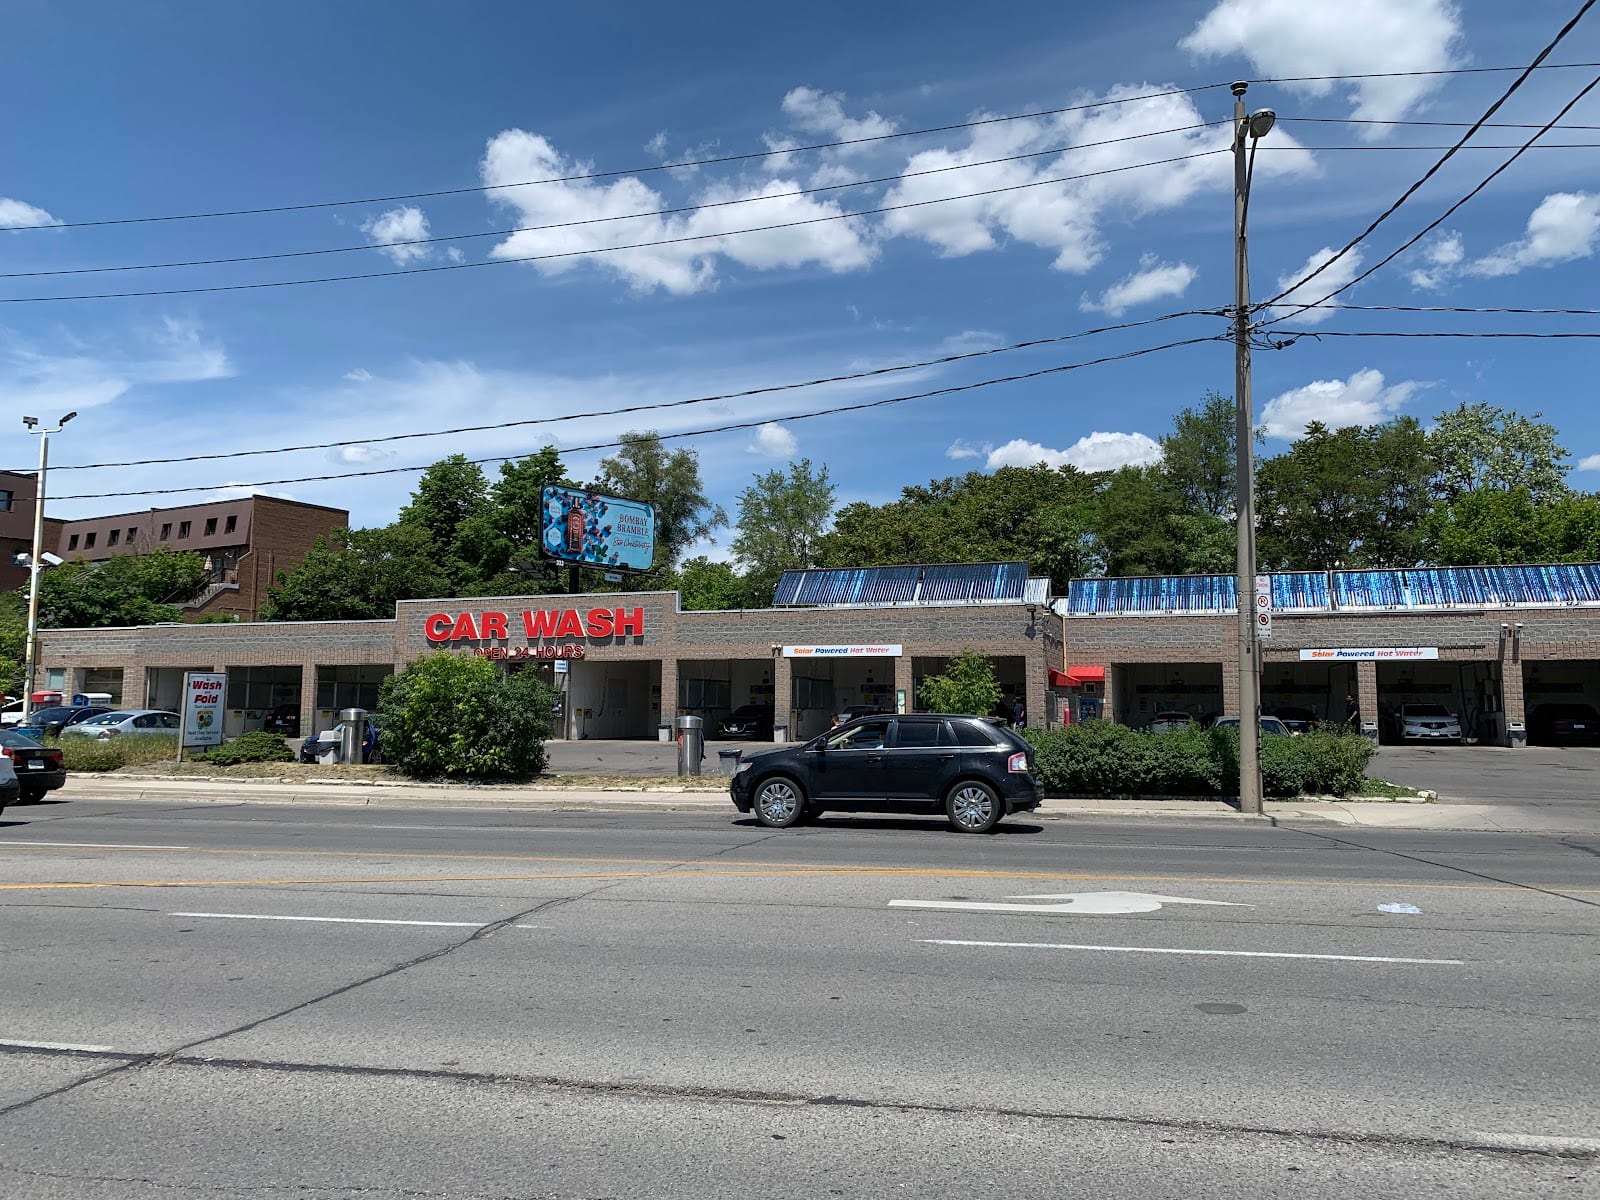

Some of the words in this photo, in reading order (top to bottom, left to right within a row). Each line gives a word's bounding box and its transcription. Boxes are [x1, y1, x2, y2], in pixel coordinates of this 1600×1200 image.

[620, 514, 648, 527] BOMBAY
[617, 523, 650, 537] BRAMBLE
[424, 611, 509, 642] CAR
[522, 607, 644, 639] WASH
[474, 647, 510, 659] OPEN
[513, 646, 530, 659] 24
[535, 645, 584, 659] HOURS
[192, 680, 222, 689] Wash
[194, 694, 218, 704] Fold
